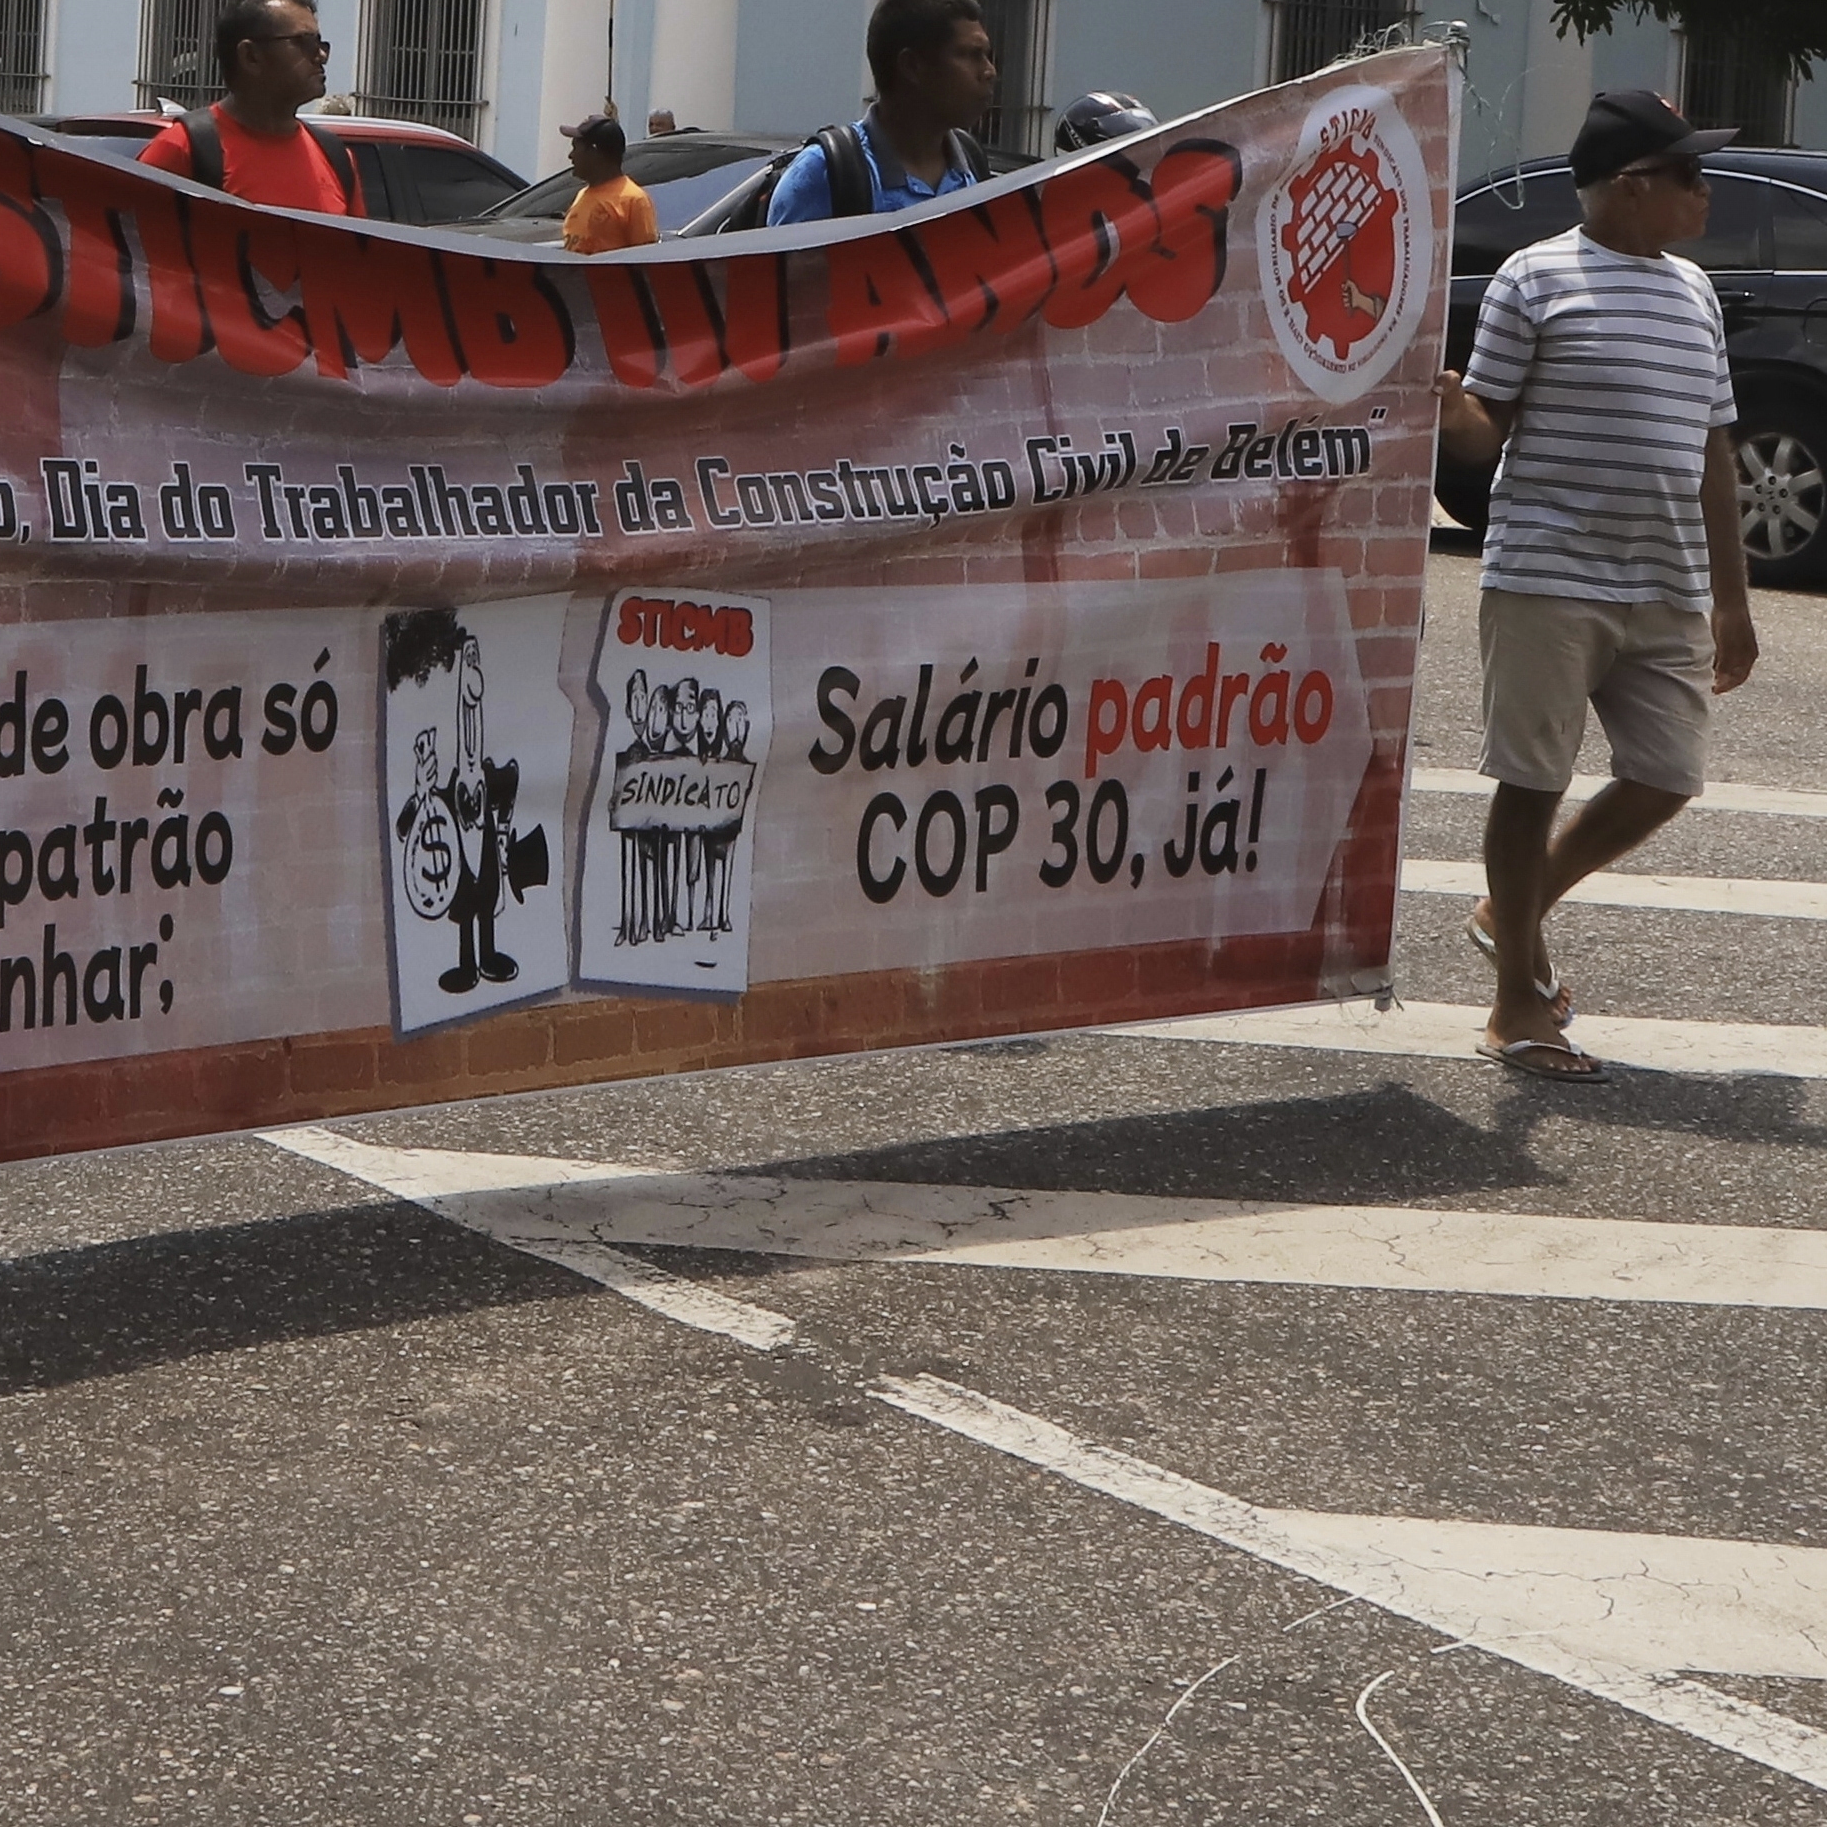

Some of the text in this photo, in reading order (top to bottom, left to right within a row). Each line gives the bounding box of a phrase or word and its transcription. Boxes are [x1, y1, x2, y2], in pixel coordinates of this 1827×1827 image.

[828, 138, 1242, 368] ANOS
[41, 457, 149, 543] Dia
[160, 460, 237, 543] do
[245, 461, 601, 543] Trabalhador
[615, 460, 693, 537] da
[697, 440, 1017, 529] Construção
[1025, 429, 1137, 506] Civil
[1139, 425, 1209, 485] de
[1209, 406, 1389, 482] Belém"
[617, 596, 755, 658] STICMB
[88, 664, 244, 769] obra
[261, 647, 341, 757] só
[807, 639, 1335, 780] Salário padrão
[619, 772, 741, 811] SINDICATO
[855, 764, 1264, 905] COP 30, já!
